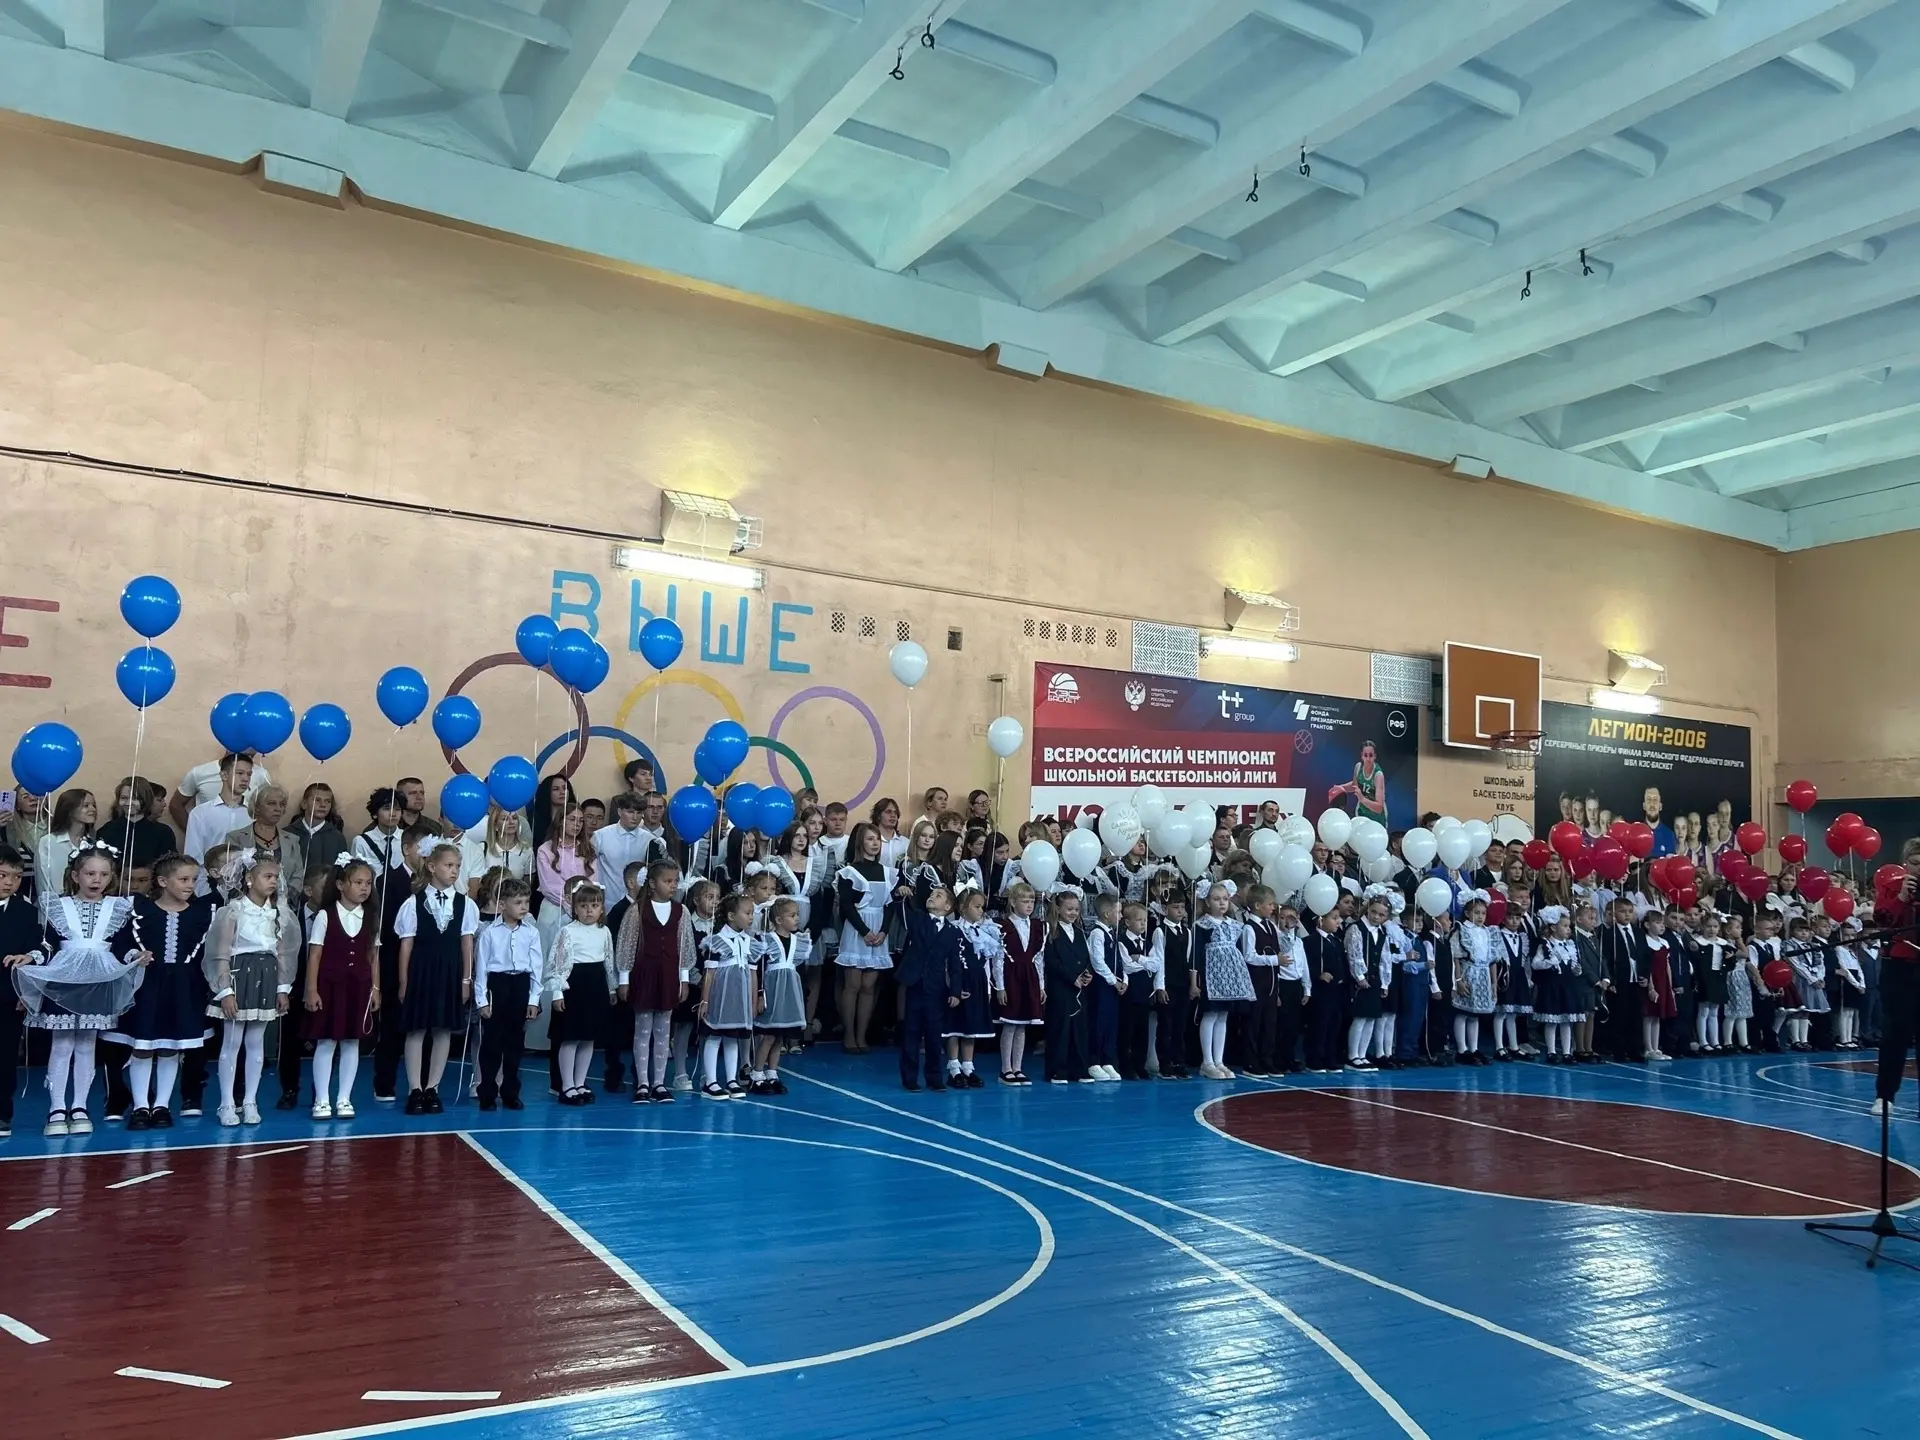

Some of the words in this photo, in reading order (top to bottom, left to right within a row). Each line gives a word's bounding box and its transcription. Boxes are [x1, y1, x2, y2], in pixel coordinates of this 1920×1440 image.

[550, 569, 814, 675] ВЫШЕ
[1234, 712, 1255, 722] group
[1310, 716, 1353, 726] ПРЕЗИДЕНТСКИХ
[1310, 723, 1334, 731] ГРАНТОВ
[1389, 719, 1405, 729] РФБ
[1588, 718, 1707, 749] ЛЕГИОН-2006
[1043, 745, 1184, 765] ВСЕРОССИЙСКИЙ
[1187, 749, 1276, 766] ЧЕМПИОНАТ
[1544, 739, 1586, 751] СЕРЕБРЯНЫЕ
[1587, 743, 1617, 754] ПРИЗЁРЫ
[1618, 747, 1642, 757] ФИНАЛА
[1642, 750, 1680, 761] УРАЛЬСКОГО
[1680, 754, 1723, 766] ФЕДЕРАЛЬНОГО
[1723, 759, 1745, 768] ОКРУГА
[1623, 758, 1637, 767] ШБЛ
[1043, 766, 1127, 783] ШКОЛЬНОЙ
[1130, 768, 1242, 784] БАСКЕТБОЛЬНОЙ
[1243, 771, 1277, 784] ЛИГИ
[1483, 775, 1525, 788] ШКОЛЬНЫЙ
[1362, 782, 1371, 794] 12
[1496, 803, 1515, 812] КЛУБ
